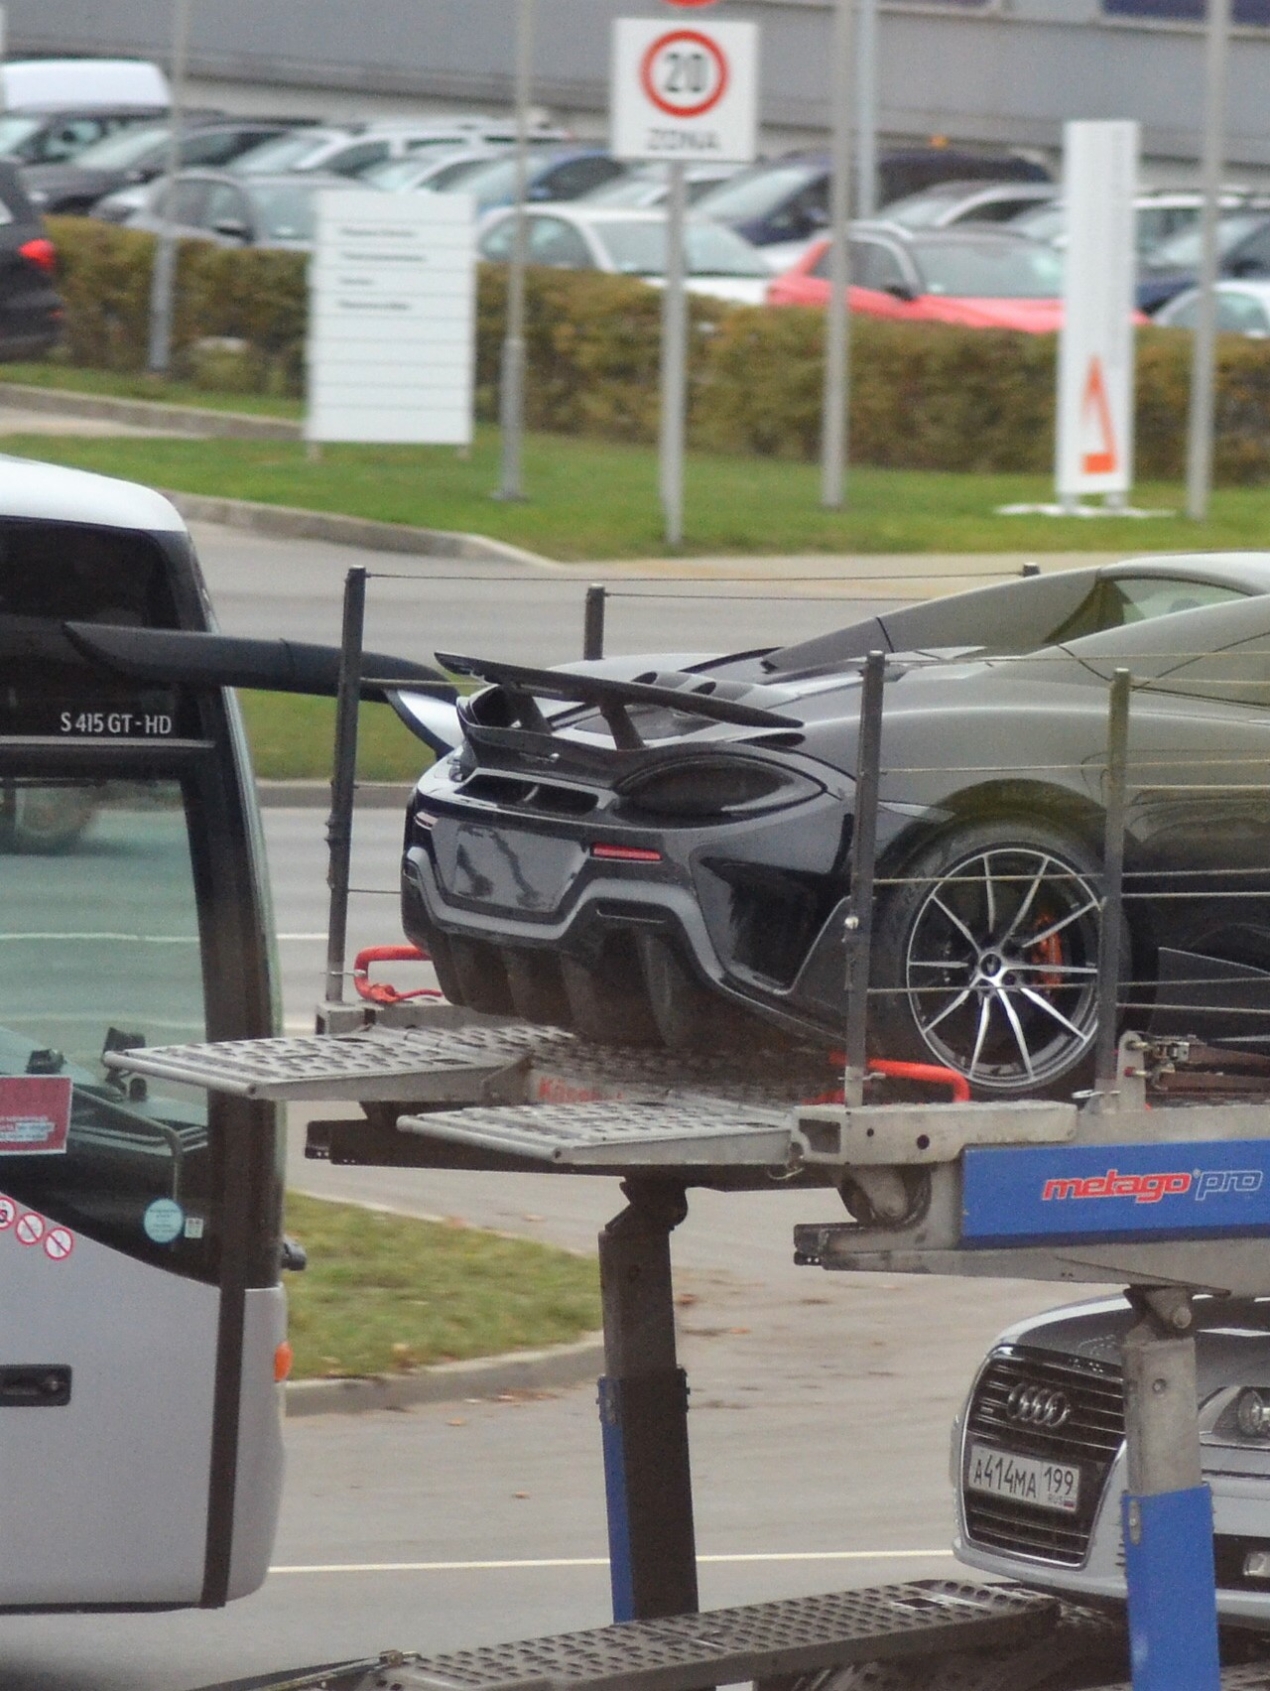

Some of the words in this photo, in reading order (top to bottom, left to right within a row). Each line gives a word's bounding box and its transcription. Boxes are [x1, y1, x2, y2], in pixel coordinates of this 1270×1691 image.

[665, 52, 709, 93] 20
[60, 711, 72, 732] S
[75, 712, 104, 733] 415
[1195, 1169, 1264, 1202] pro
[1044, 1466, 1075, 1496] 199
